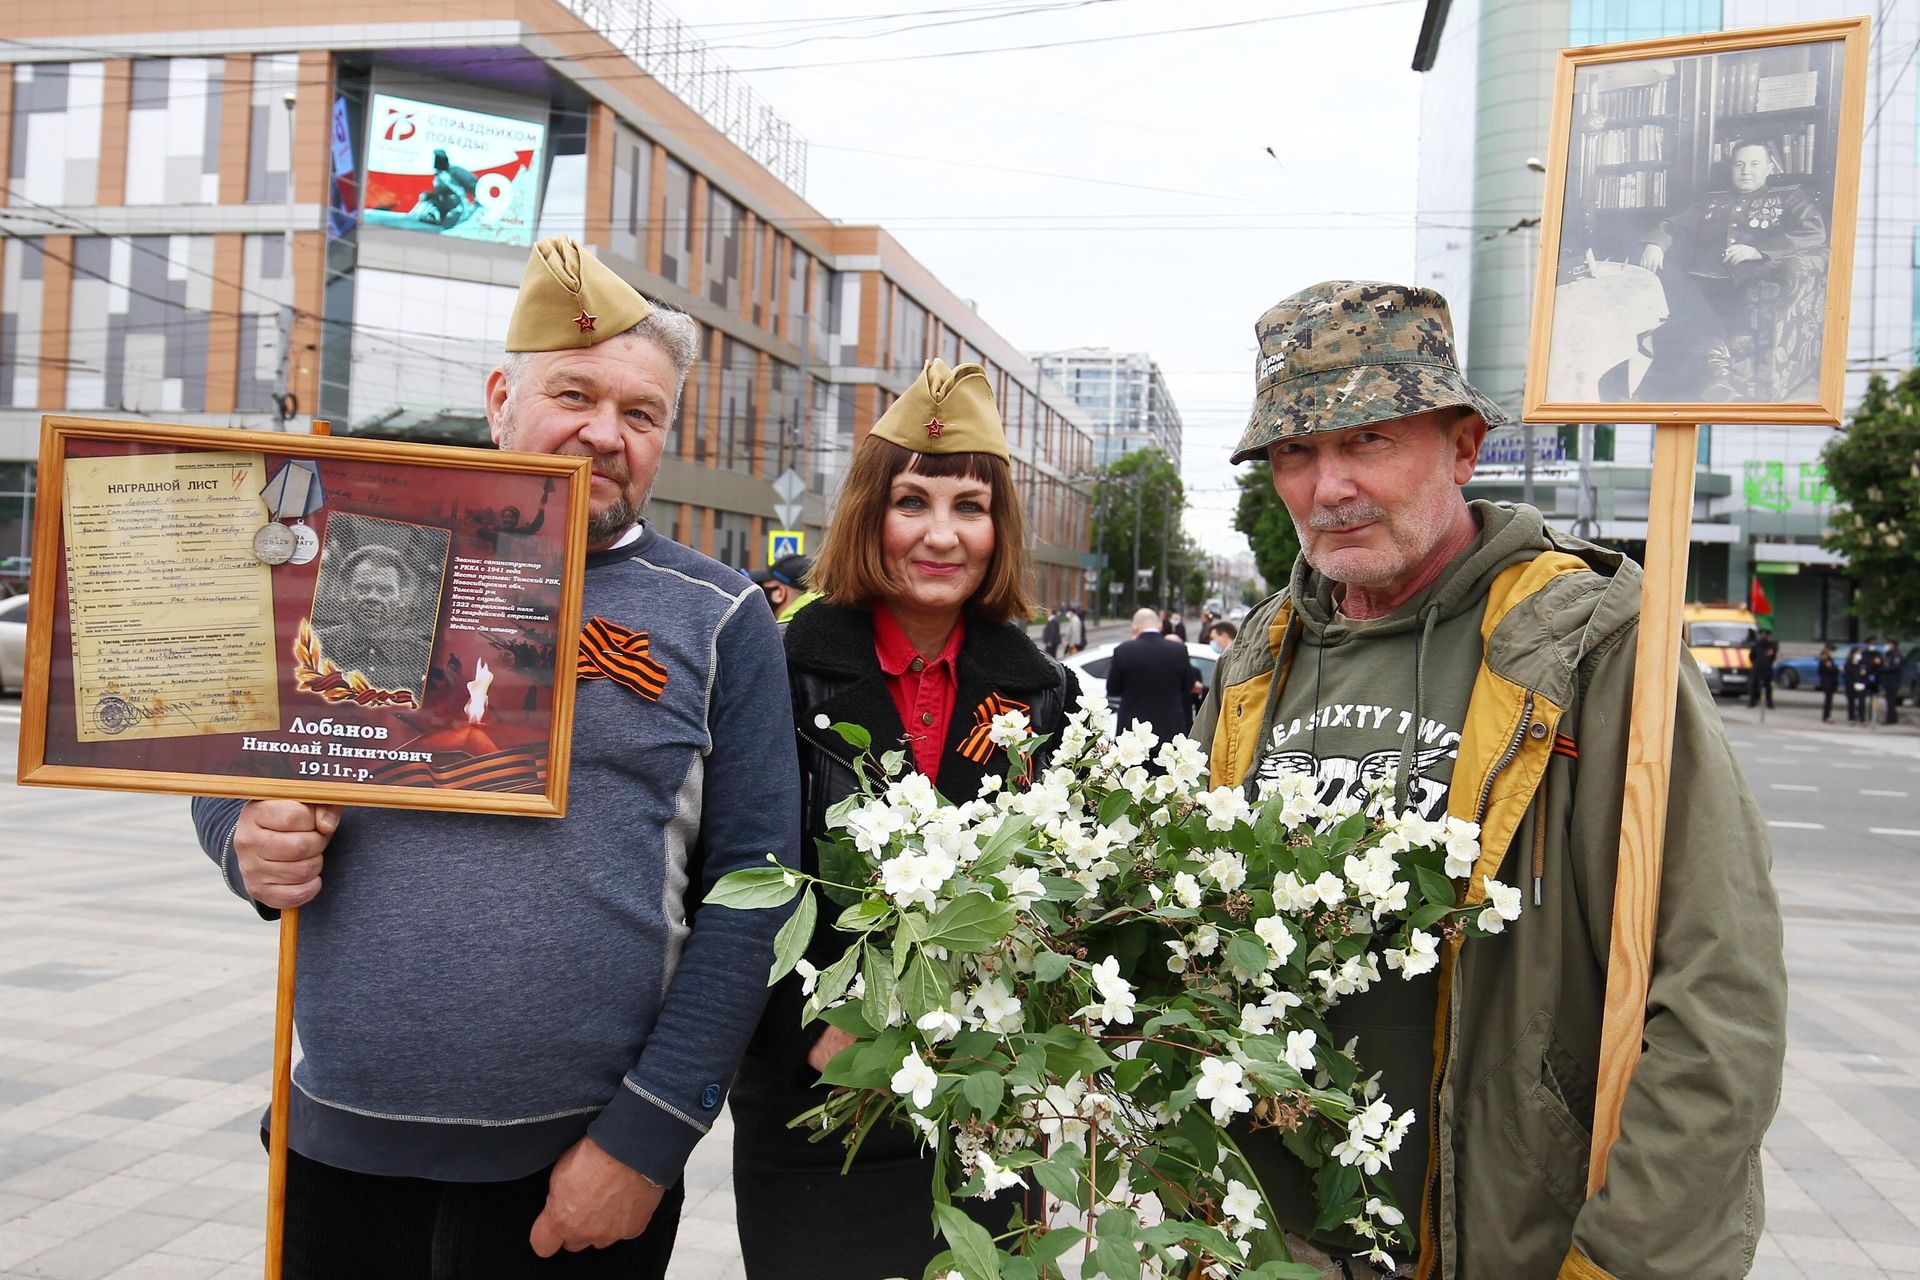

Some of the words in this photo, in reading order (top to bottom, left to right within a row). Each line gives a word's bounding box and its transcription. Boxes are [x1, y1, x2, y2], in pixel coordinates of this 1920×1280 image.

[1268, 361, 1285, 375] TOUR
[108, 480, 180, 494] НАГРАДНОЙ
[187, 480, 219, 491] ЛИСТ
[454, 556, 482, 564] Звание:
[483, 559, 542, 569] санинструктор
[460, 564, 479, 572] РККА
[452, 579, 507, 588] Новосибирская
[478, 574, 511, 582] призыва:
[513, 576, 544, 584] Томский
[452, 586, 484, 594] Томский
[470, 603, 515, 612] стрелковый
[461, 610, 506, 618] гвардейской
[506, 613, 549, 622] стрелковой
[449, 623, 476, 631] Медаль
[289, 717, 388, 739] Лобанов
[1266, 718, 1301, 752] EA
[1305, 704, 1392, 731] SIXTY
[1396, 711, 1462, 758] TWO
[242, 736, 322, 755] Николай
[327, 743, 432, 763] Никитович
[298, 761, 374, 782] 1911г.р.
